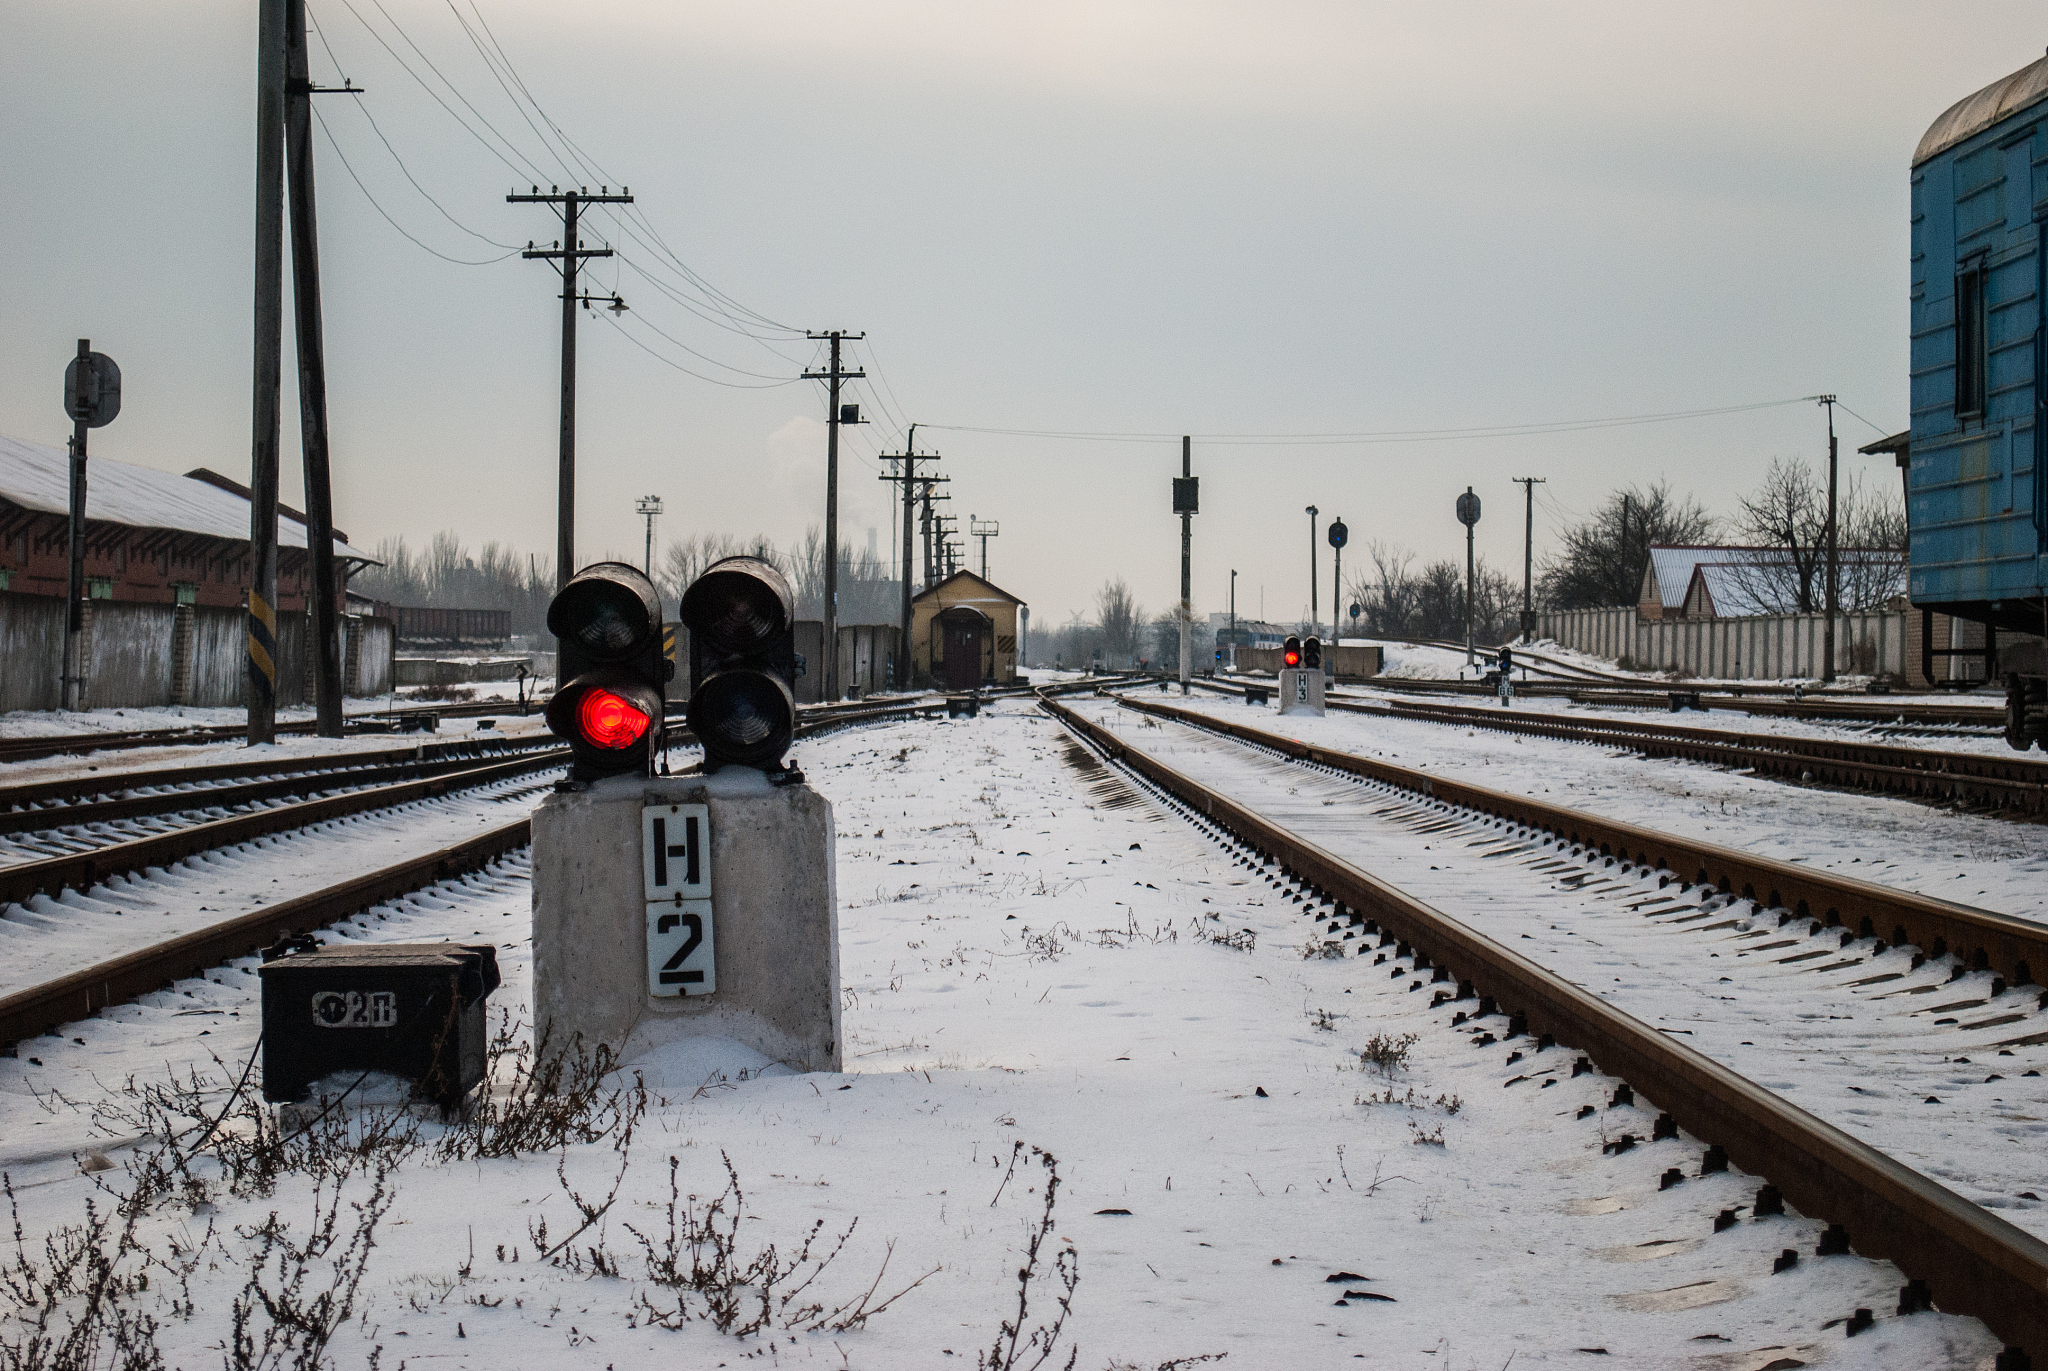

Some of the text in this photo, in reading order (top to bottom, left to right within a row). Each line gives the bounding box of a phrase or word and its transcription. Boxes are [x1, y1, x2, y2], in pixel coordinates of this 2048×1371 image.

[1298, 690, 1306, 700] 3
[653, 817, 700, 886] Н
[657, 914, 704, 984] 2
